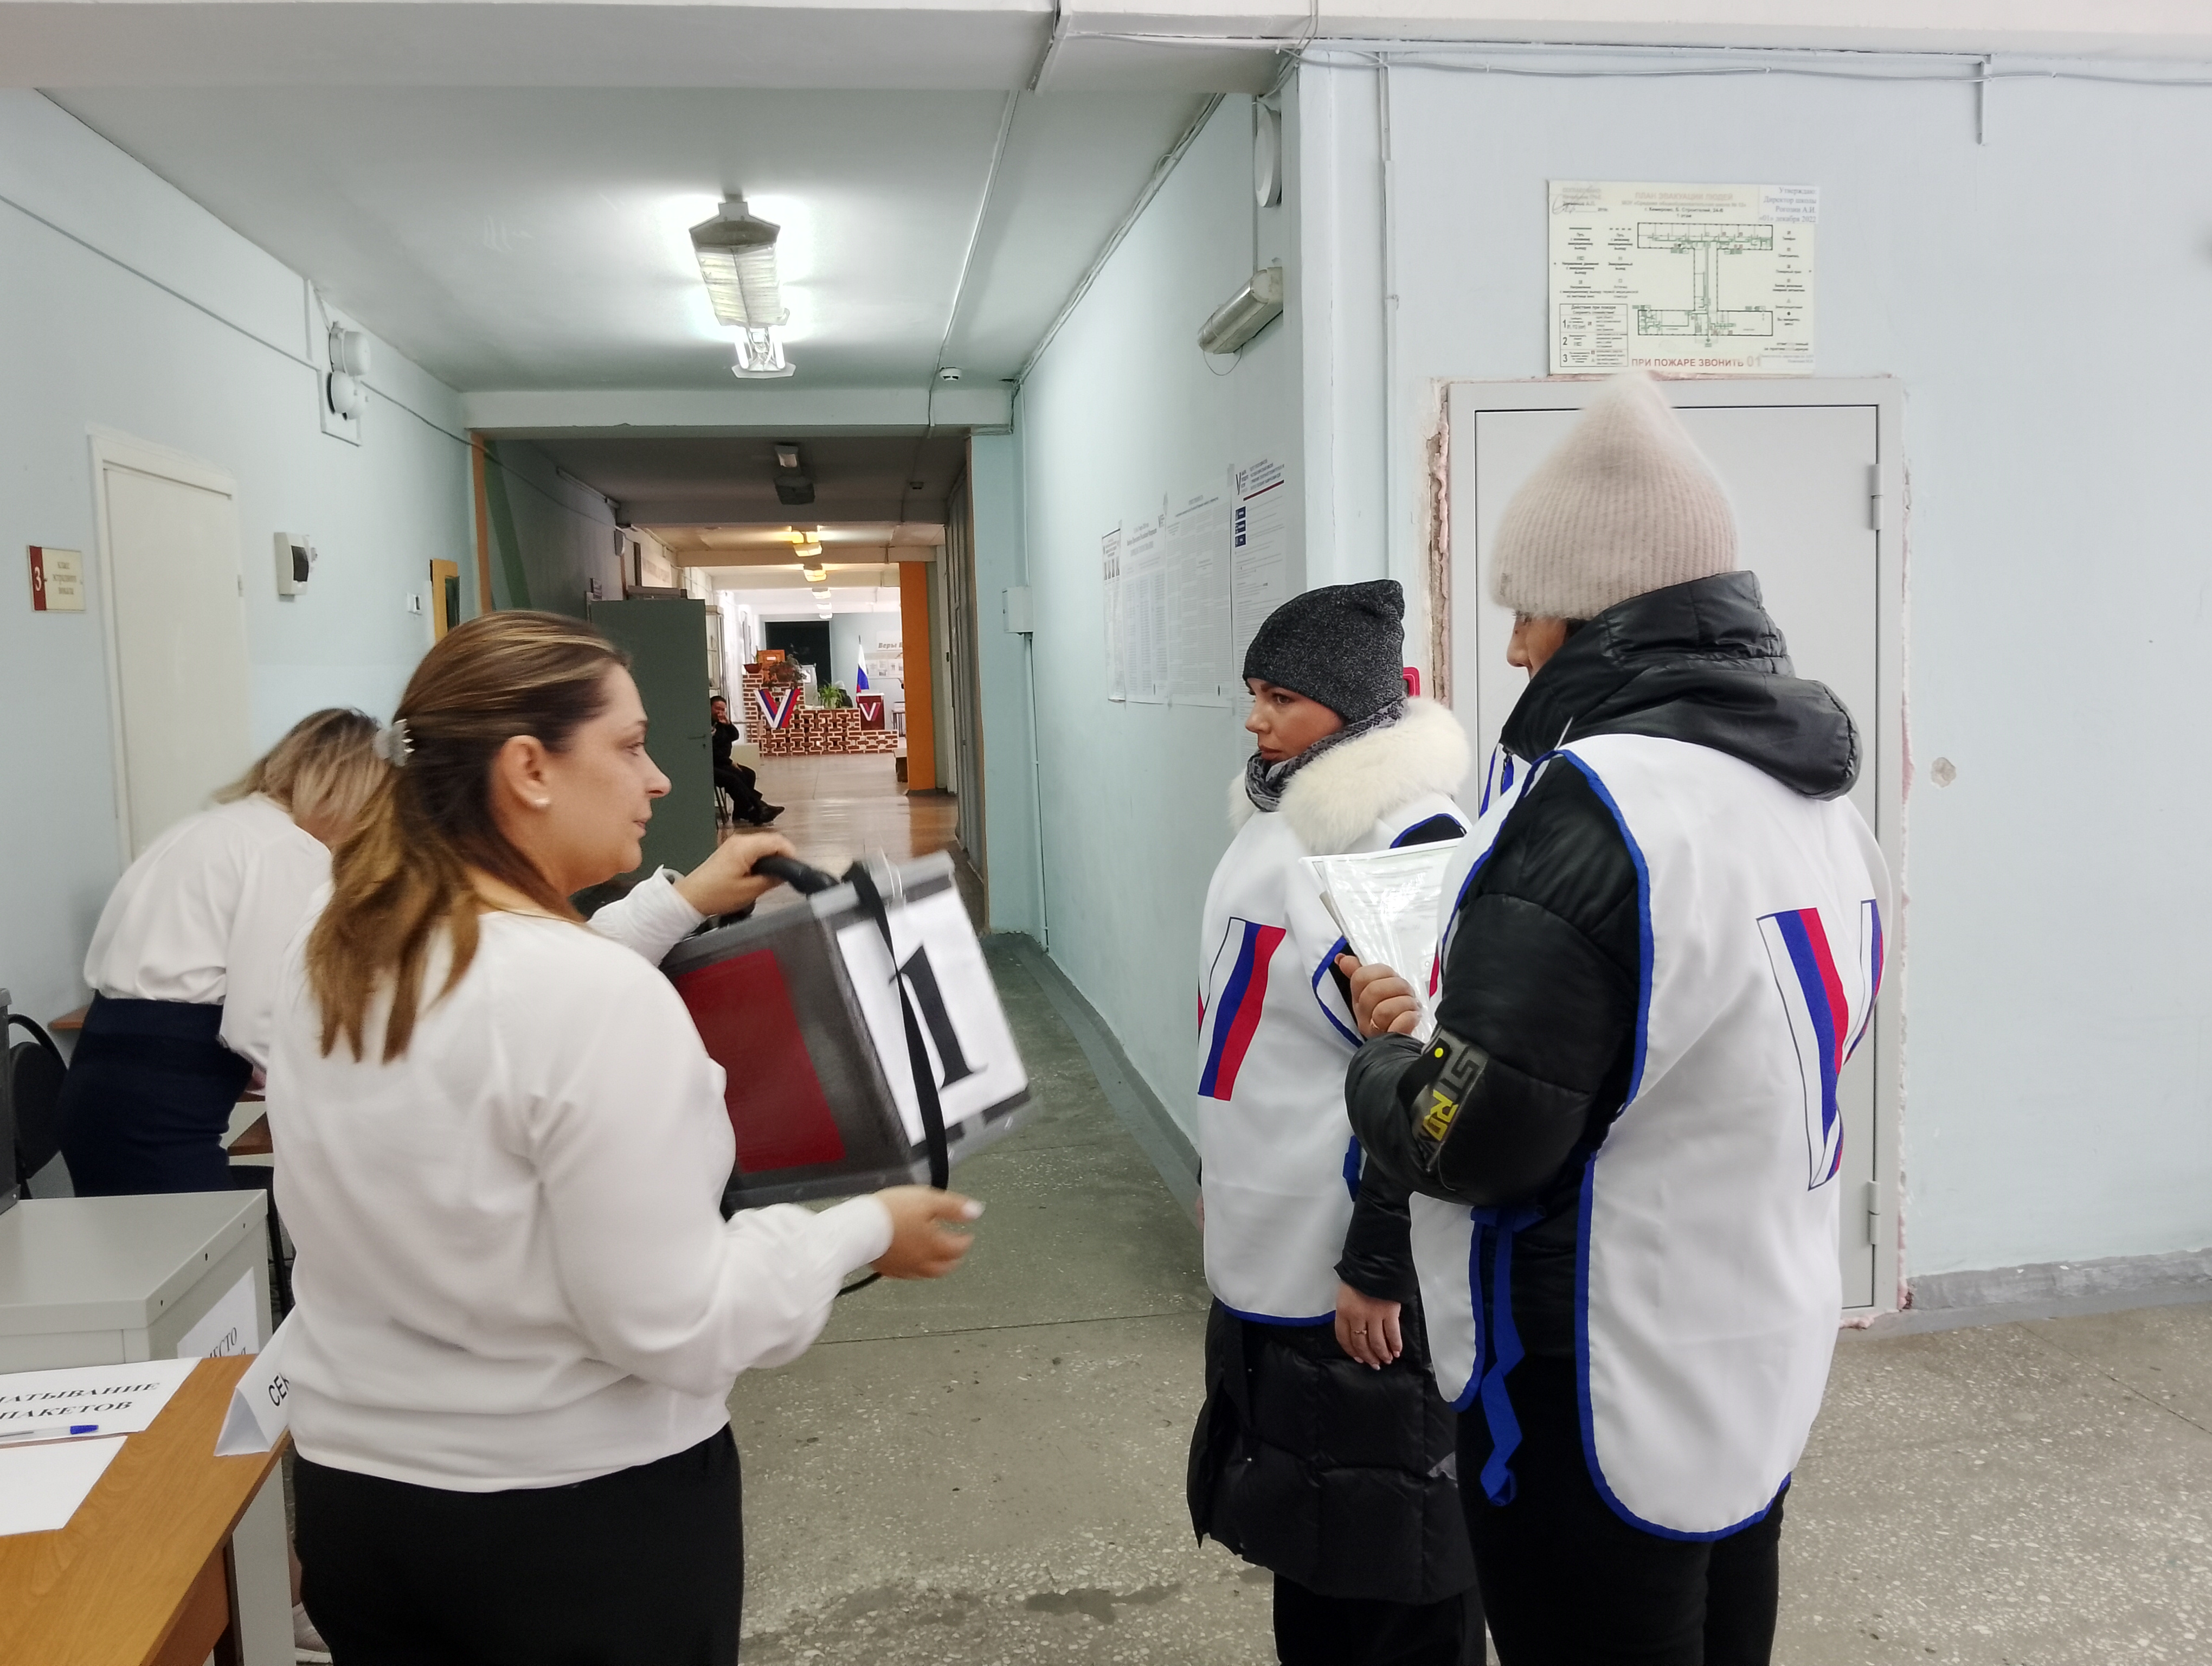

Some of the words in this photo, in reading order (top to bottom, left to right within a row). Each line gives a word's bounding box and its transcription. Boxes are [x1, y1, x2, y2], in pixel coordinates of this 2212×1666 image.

[1562, 319, 1566, 328] 1
[1562, 337, 1568, 345] 2
[1562, 354, 1568, 363] 3
[1631, 358, 1651, 367] ПРИ
[1654, 358, 1696, 367] ПОЖАРЕ
[1699, 358, 1744, 367] ЗВОНИТЬ
[34, 566, 42, 591] 3
[887, 943, 989, 1091] 1
